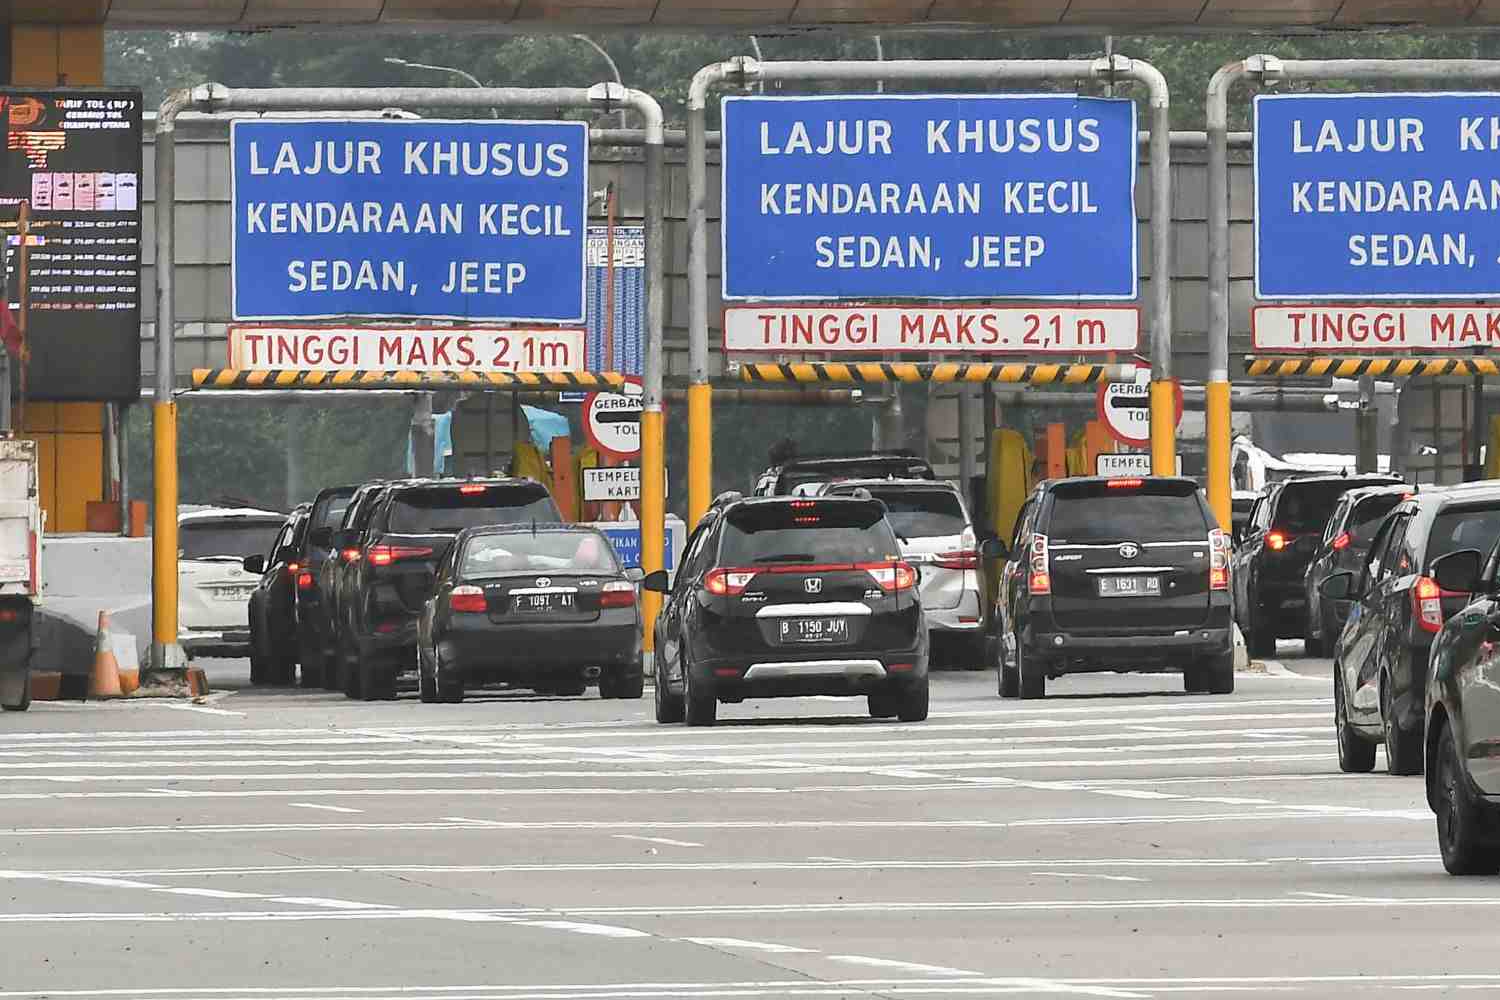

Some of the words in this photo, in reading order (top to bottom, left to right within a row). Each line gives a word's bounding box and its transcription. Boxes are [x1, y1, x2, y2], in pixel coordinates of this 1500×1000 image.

[760, 119, 892, 155] LAJUR
[927, 118, 1100, 154] KHUSUS
[1293, 118, 1425, 153] LAJUR
[251, 142, 381, 176] LAJUR
[405, 142, 569, 177] KHUSUS
[760, 182, 981, 215] KENDARAAN
[1004, 181, 1098, 214] KECIL
[247, 202, 463, 234] KENDARAAN
[479, 203, 571, 236] KECIL
[815, 235, 941, 271] SEDAN,
[965, 236, 1045, 268] JEEP
[1348, 233, 1475, 267] SEDAN,
[288, 261, 418, 295] SEDAN,
[442, 262, 526, 294] JEEP
[758, 313, 878, 345] TINGGI
[900, 314, 1009, 344] MAKS.
[1288, 313, 1405, 342] TINGGI
[245, 335, 359, 365] TINGGI
[379, 336, 482, 366] MAKS.
[594, 399, 643, 409] GERBAN
[590, 472, 641, 482] TEMPEL
[1104, 458, 1150, 468] TEMPEL
[607, 486, 640, 496] KART
[782, 621, 789, 634] B
[799, 621, 822, 634] 1150
